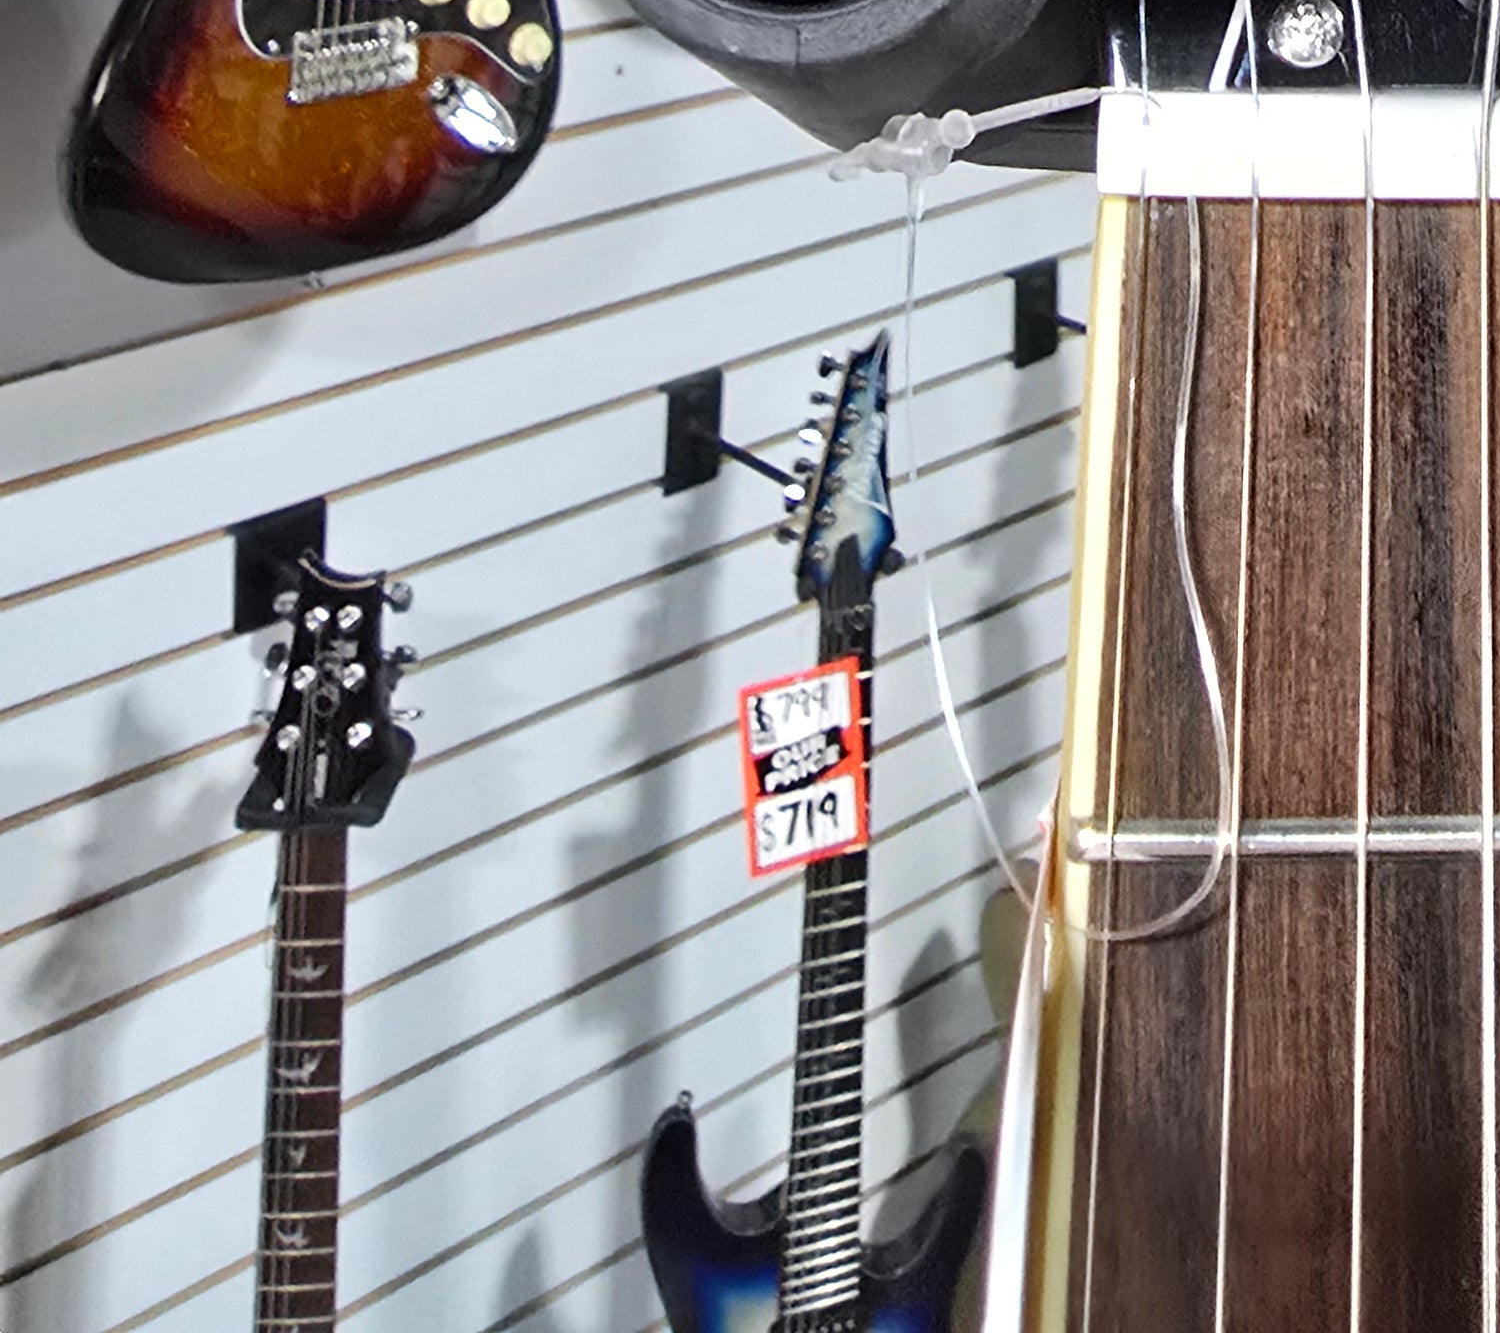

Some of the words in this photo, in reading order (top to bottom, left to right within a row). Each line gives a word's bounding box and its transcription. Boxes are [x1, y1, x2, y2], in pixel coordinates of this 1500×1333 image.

[763, 744, 841, 793] PRICE
[771, 734, 827, 770] OUR
[759, 791, 839, 853] $719
